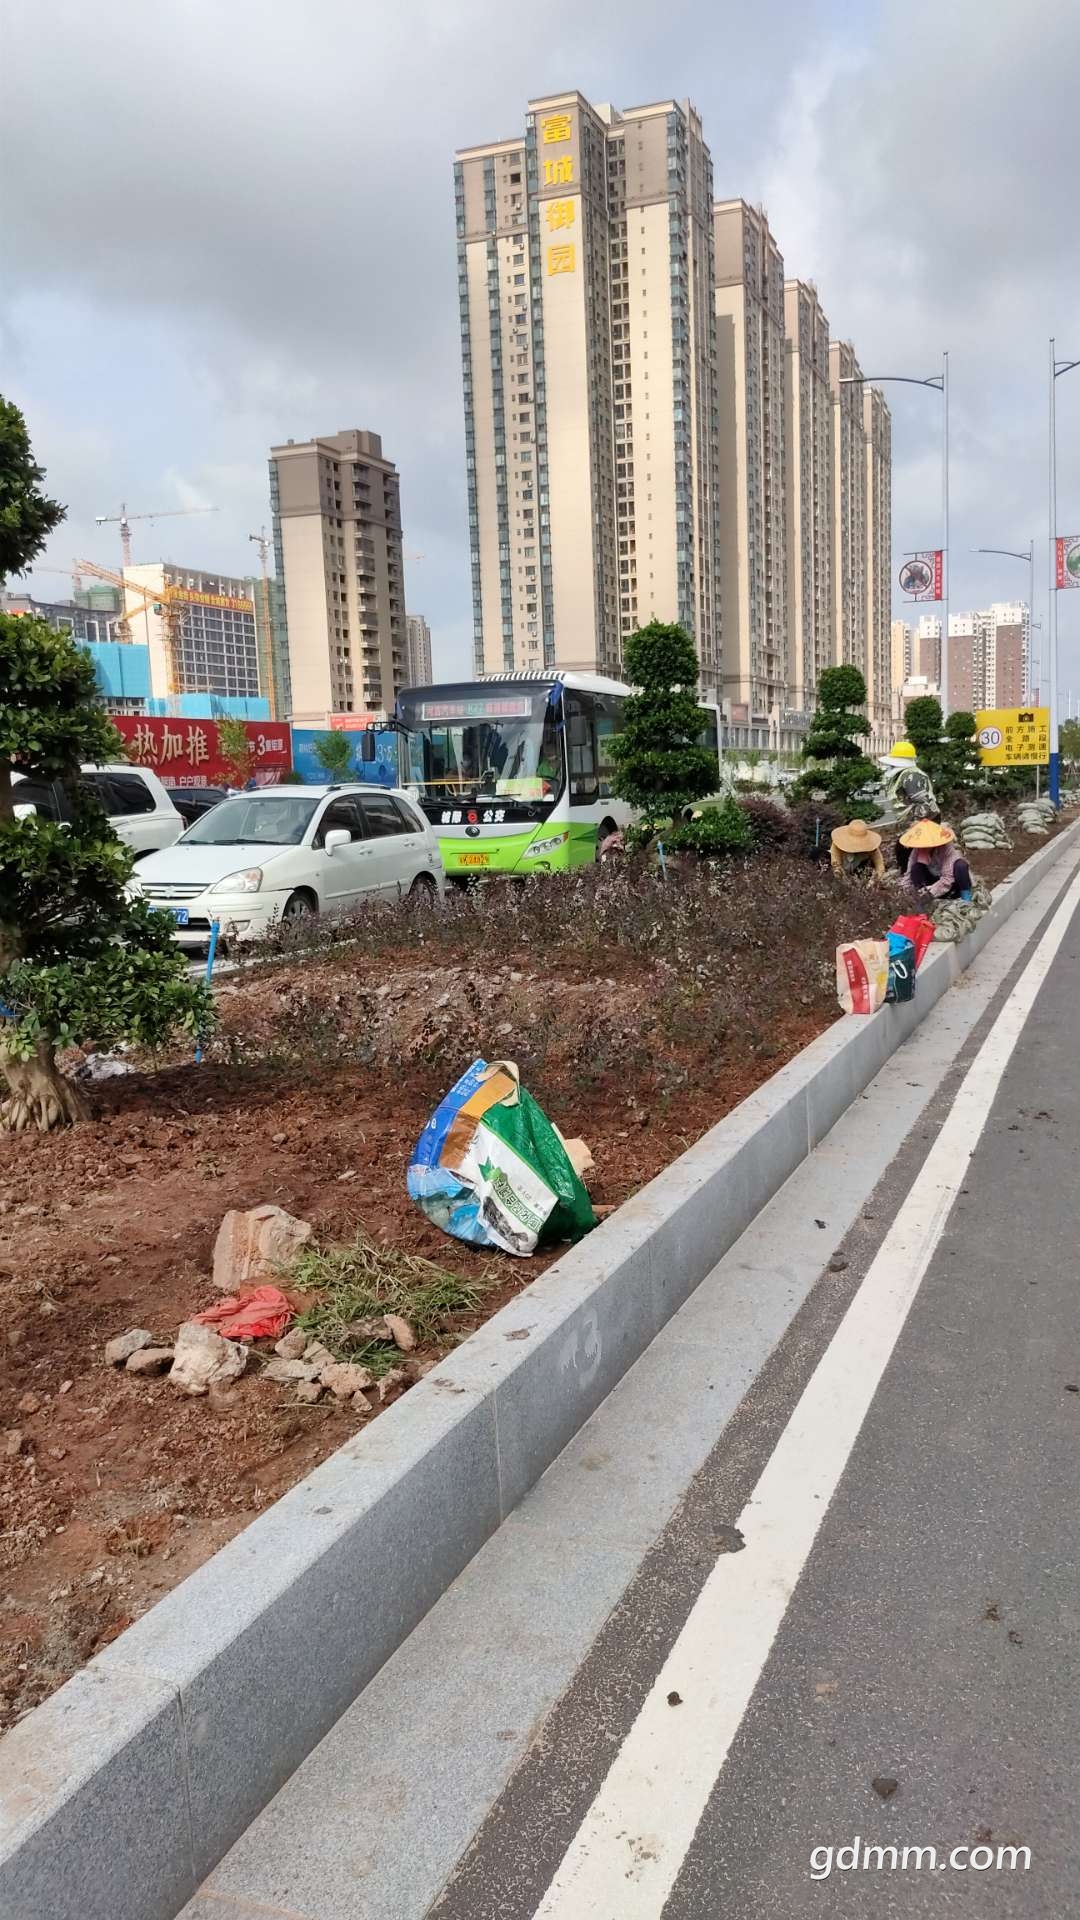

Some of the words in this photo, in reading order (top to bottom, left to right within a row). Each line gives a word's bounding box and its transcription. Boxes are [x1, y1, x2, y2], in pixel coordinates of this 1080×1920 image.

[541, 114, 576, 276] 富城御园
[1005, 725, 1047, 734] 前方施工
[981, 731, 1000, 745] 30
[482, 809, 506, 823] 公交
